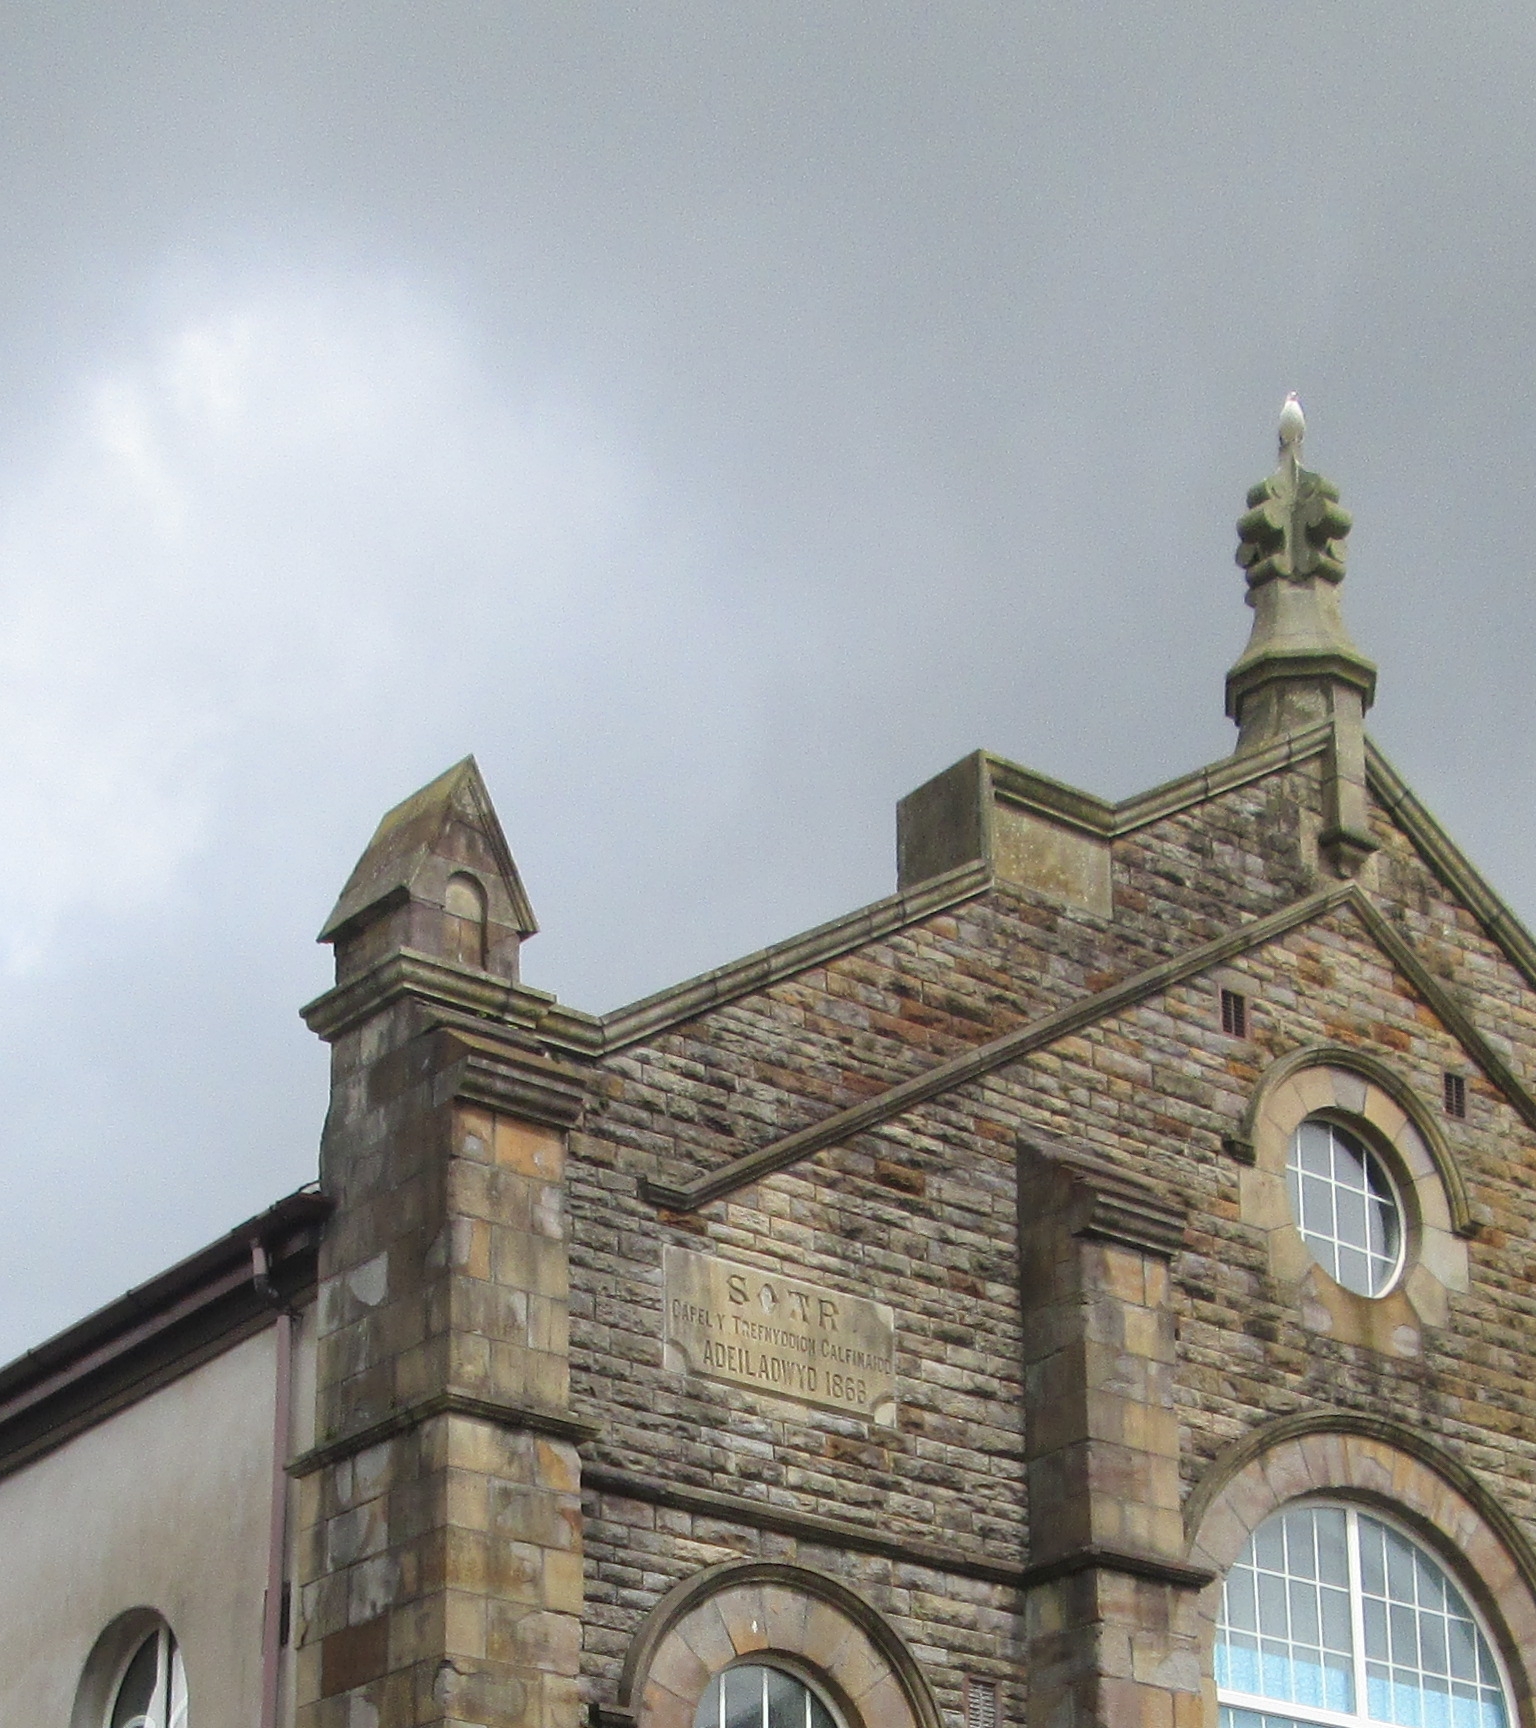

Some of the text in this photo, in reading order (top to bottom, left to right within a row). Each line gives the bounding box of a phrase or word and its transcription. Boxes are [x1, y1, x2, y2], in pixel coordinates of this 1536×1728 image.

[671, 1298, 712, 1329] CAPEL
[716, 1313, 726, 1331] Y
[731, 1315, 816, 1355] TREFNYDDION
[703, 1340, 816, 1392] ADEILADWYD
